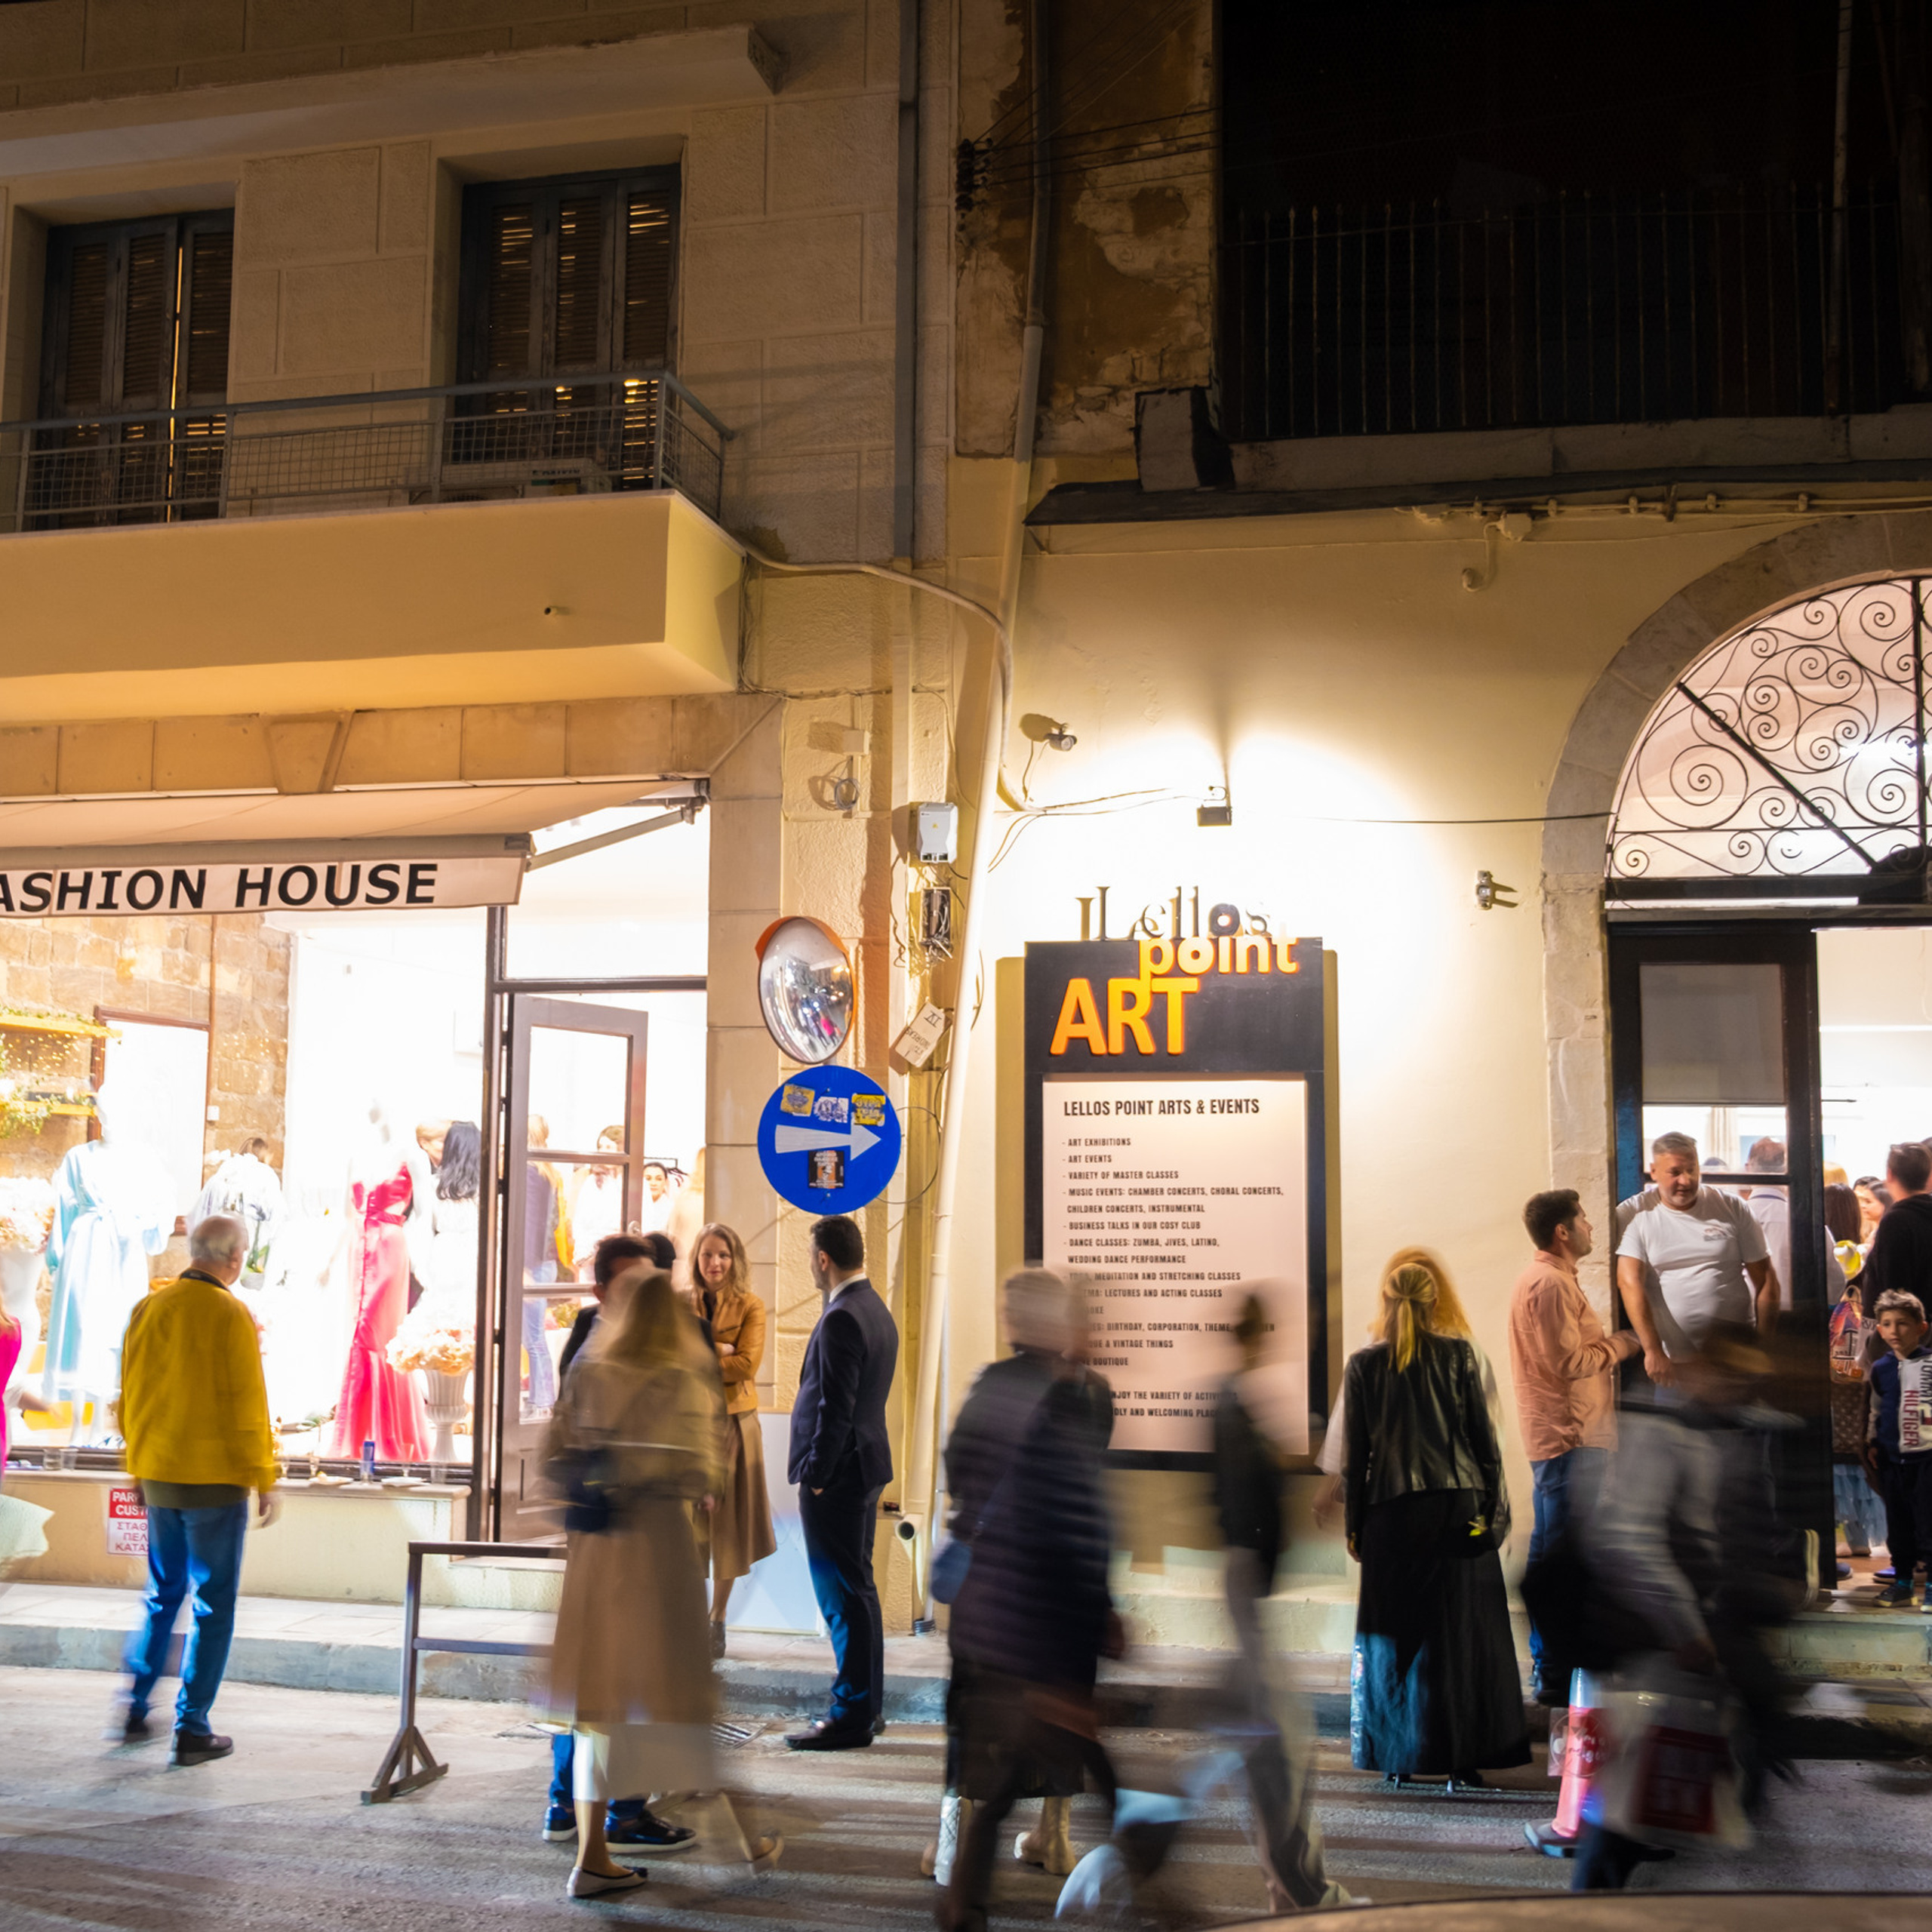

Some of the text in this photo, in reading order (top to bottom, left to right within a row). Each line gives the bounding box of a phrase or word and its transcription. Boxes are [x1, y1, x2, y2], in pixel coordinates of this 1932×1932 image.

[235, 863, 438, 908] HOUSE
[1138, 931, 1300, 980] point
[1049, 977, 1201, 1055] ART
[1063, 1098, 1260, 1116] LELLOS POINT ARTS & EVENTS
[1068, 1137, 1131, 1146] ART EXHIBITIONS
[1068, 1154, 1112, 1163] ART EVENTS
[1069, 1171, 1179, 1180] VARIETY OF MASTER CLASSES
[1068, 1188, 1094, 1196] MUSIC
[1128, 1187, 1164, 1195] CHAMBER
[1167, 1187, 1208, 1196] CONCERTS,
[1210, 1187, 1240, 1195] CHORAL
[1242, 1186, 1284, 1196] CONCERTS,
[1066, 1204, 1205, 1214] CHILDREN CONCERTS, INSTRUMENTAL
[1069, 1221, 1201, 1230] BUSINESS TALKS IN OUR COSY CLUB
[1069, 1238, 1094, 1247] DANCE
[1133, 1238, 1162, 1247] ZUMBA,
[1164, 1238, 1189, 1247] JIVES,
[1191, 1238, 1220, 1247] LATINO,
[1068, 1255, 1186, 1263] WEDDING DANCE PERFORMANCE
[1094, 1272, 1140, 1281] MEDITATION
[1141, 1272, 1157, 1281] AND
[1158, 1272, 1205, 1281] STRETCHING
[1208, 1272, 1241, 1281] CLASSES
[1104, 1289, 1141, 1297] LECTURES
[1143, 1289, 1158, 1297] AND
[1160, 1289, 1188, 1297] ACTING
[1189, 1289, 1223, 1297] CLASSES
[1147, 1322, 1202, 1333] CORPORATION,
[1112, 1340, 1143, 1348] VINTAGE
[1146, 1340, 1174, 1348] THINGS
[1092, 1358, 1129, 1366] BOUTIQUE
[1134, 1391, 1148, 1399] THE
[1149, 1391, 1181, 1400] VARIETY
[1183, 1392, 1192, 1400] OF
[1129, 1408, 1146, 1417] AND
[1147, 1408, 1194, 1417] WELCOMING
[1195, 1409, 1219, 1417] PLAC
[1903, 1390, 1921, 1447] HILFIGER
